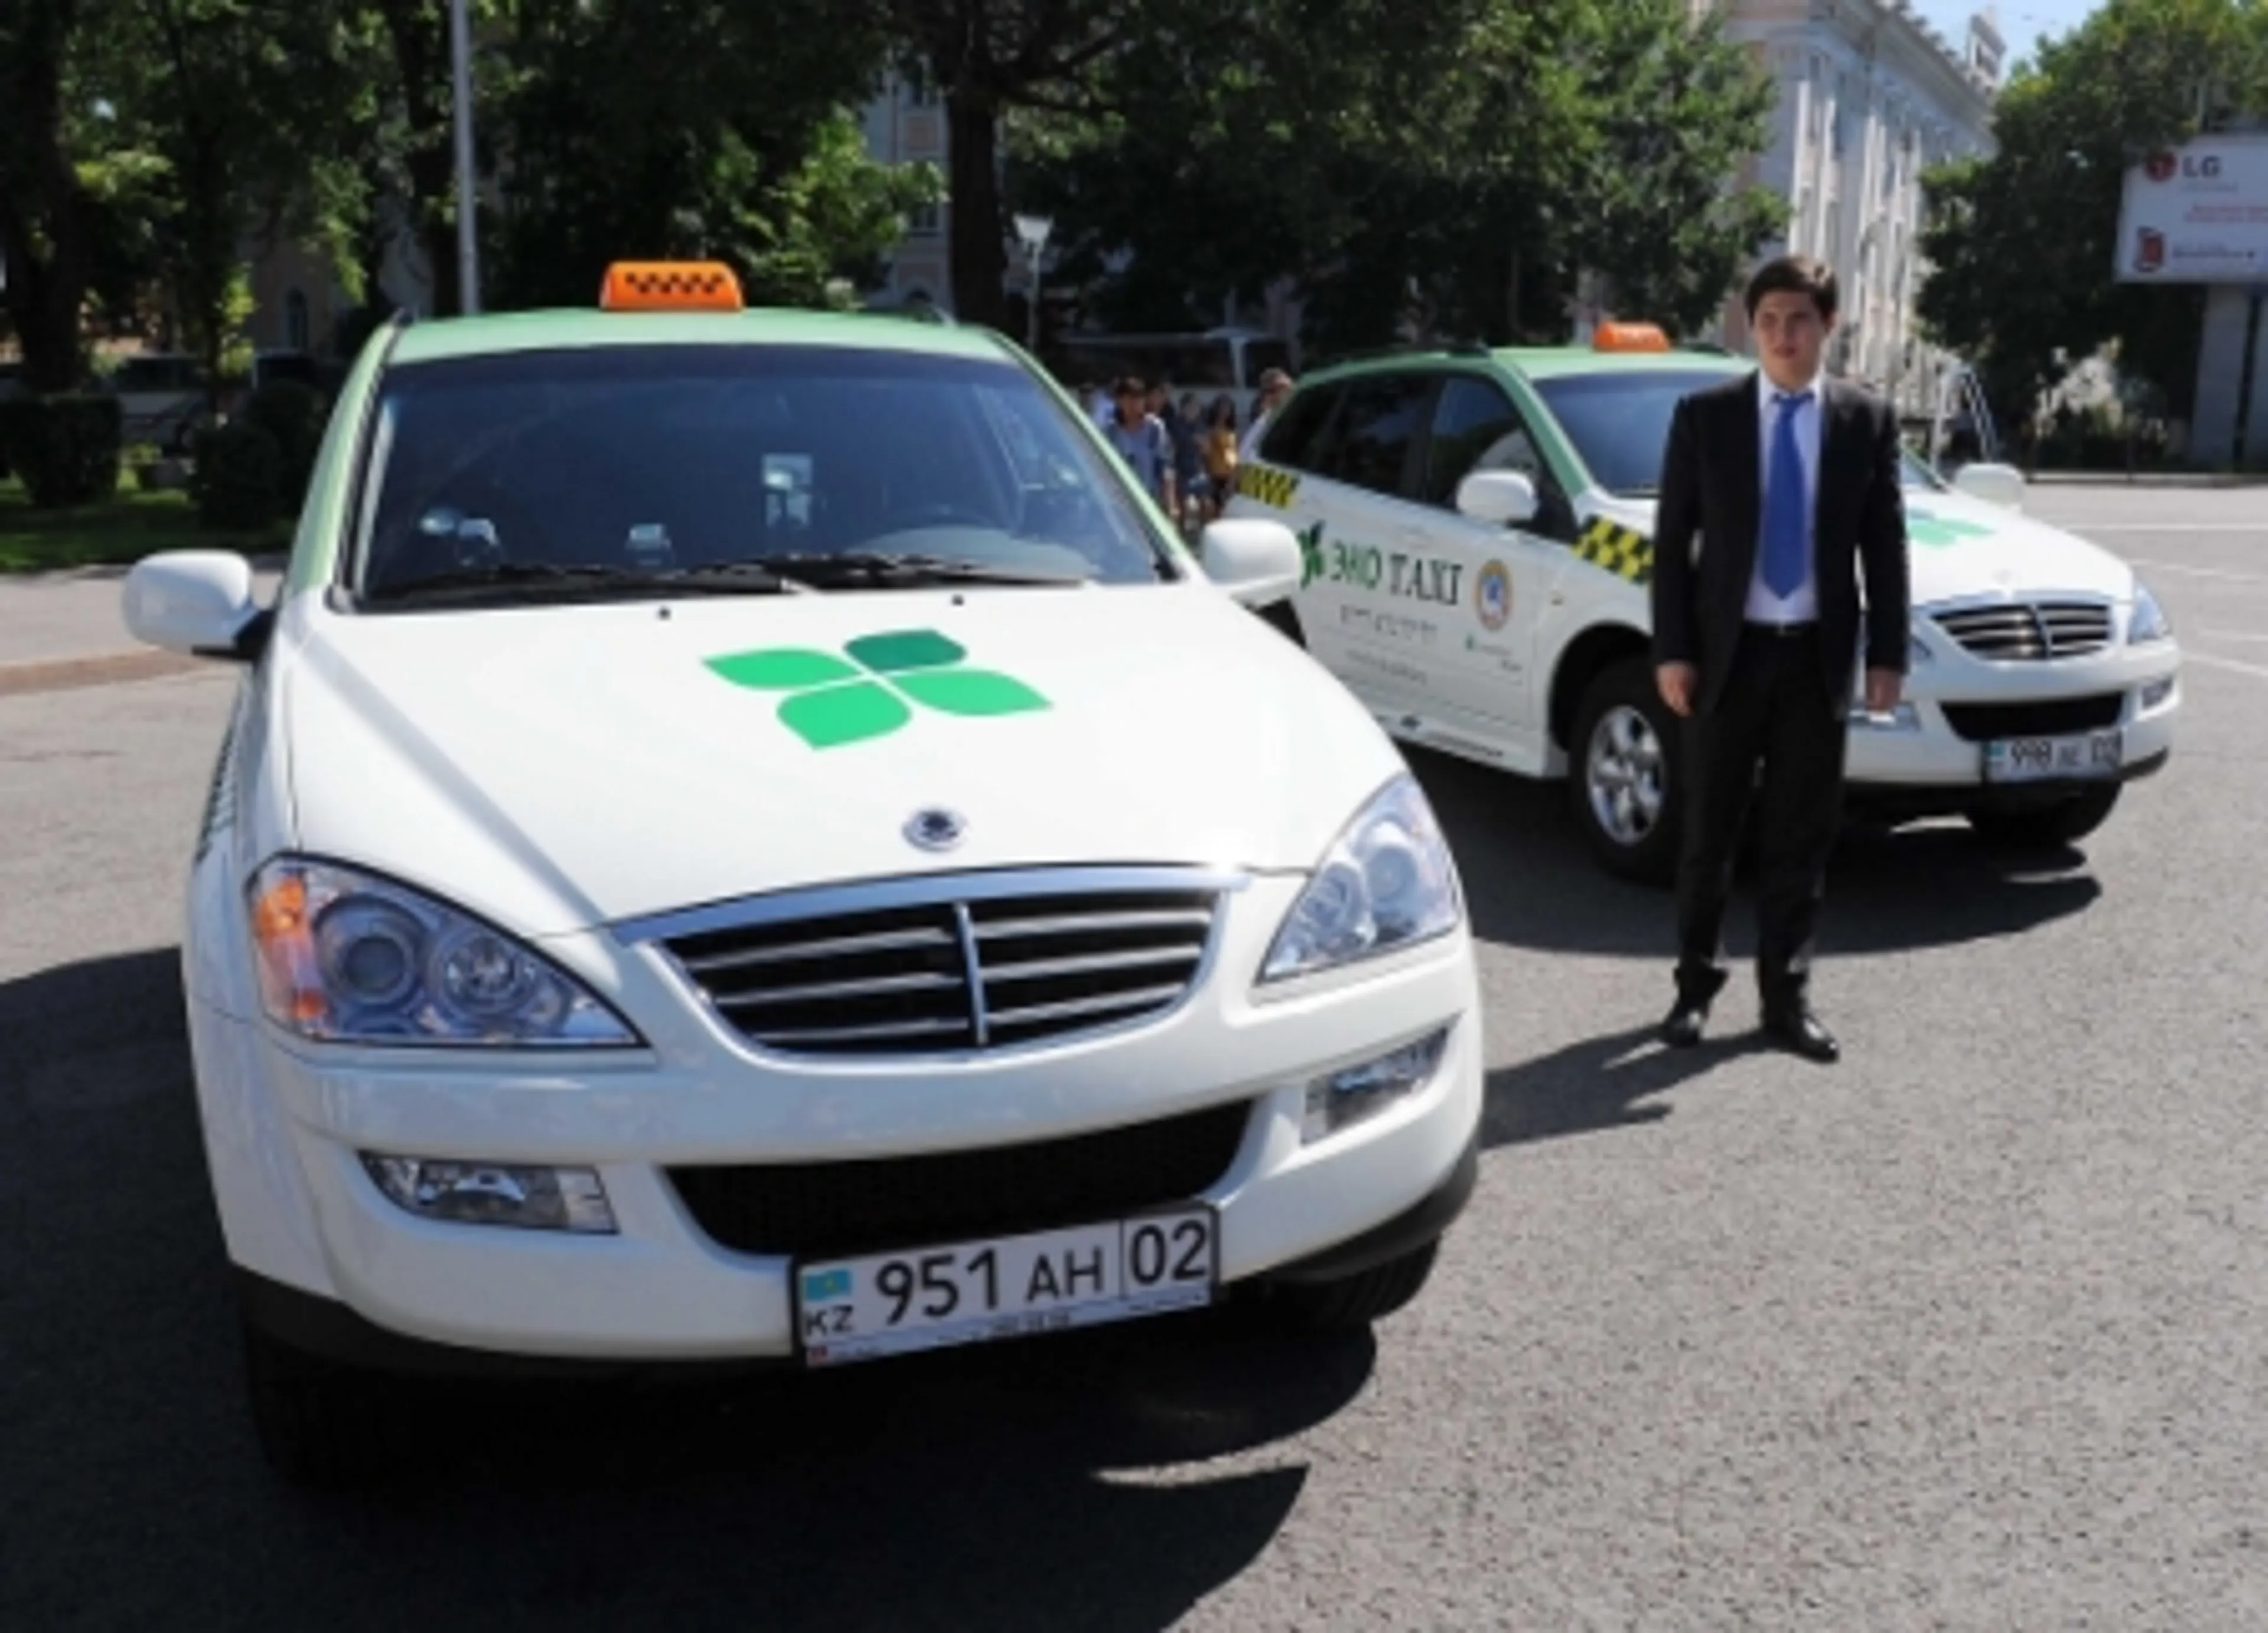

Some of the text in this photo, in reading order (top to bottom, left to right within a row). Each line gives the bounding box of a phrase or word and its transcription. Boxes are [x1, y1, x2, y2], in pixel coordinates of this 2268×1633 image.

[2182, 155, 2221, 179] LG
[1390, 554, 1463, 605] TAXI
[875, 1247, 999, 1327] 951
[1025, 1246, 1103, 1302] AH
[1129, 1220, 1208, 1286] 02
[806, 1304, 854, 1337] KZ
